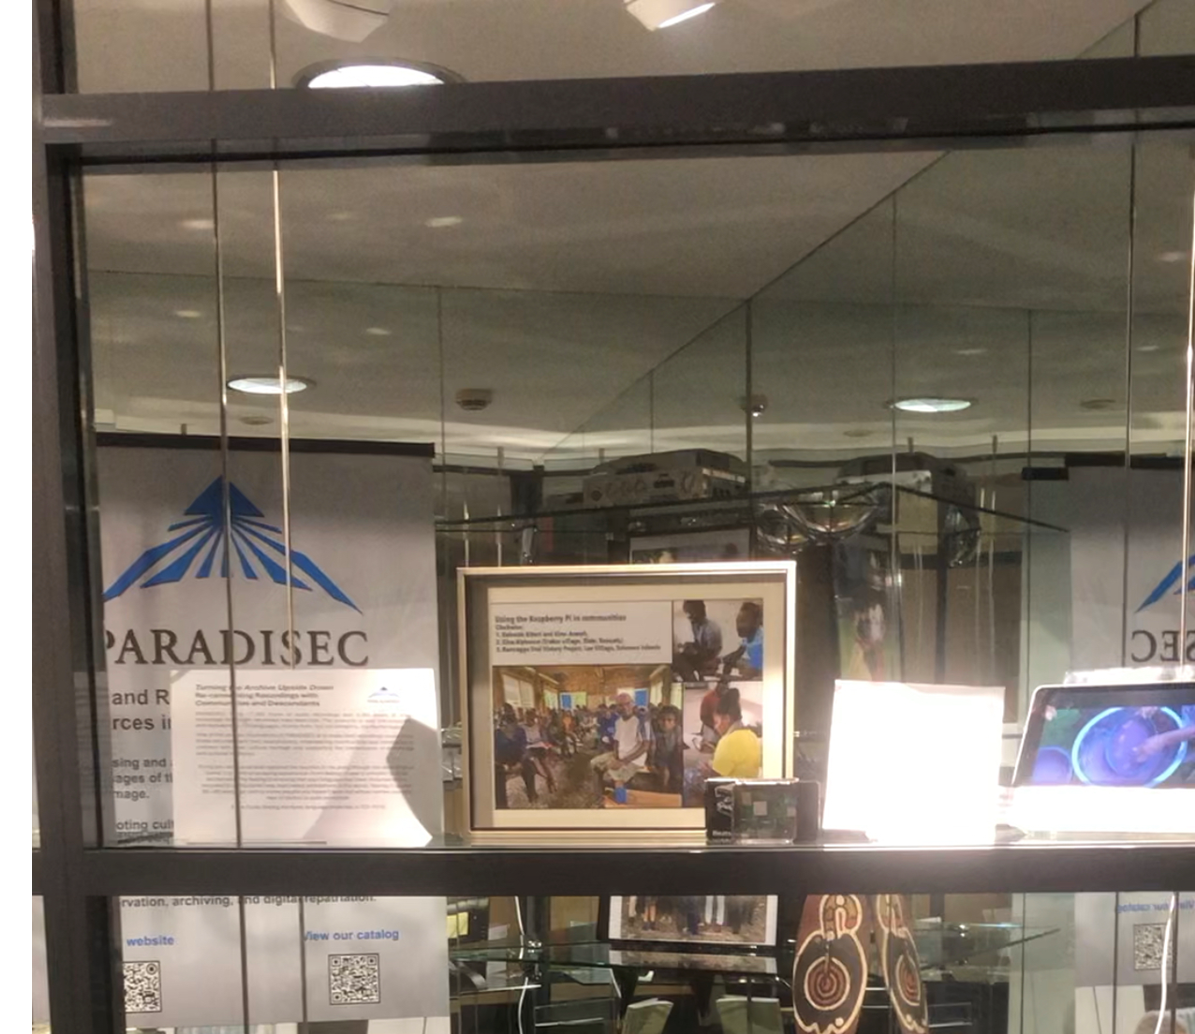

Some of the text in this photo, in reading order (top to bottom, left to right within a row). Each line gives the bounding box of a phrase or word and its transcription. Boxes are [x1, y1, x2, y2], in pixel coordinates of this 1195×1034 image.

[112, 689, 148, 705] and
[144, 758, 166, 767] and
[127, 936, 174, 946] website
[333, 932, 354, 941] our
[357, 930, 399, 942] catalog
